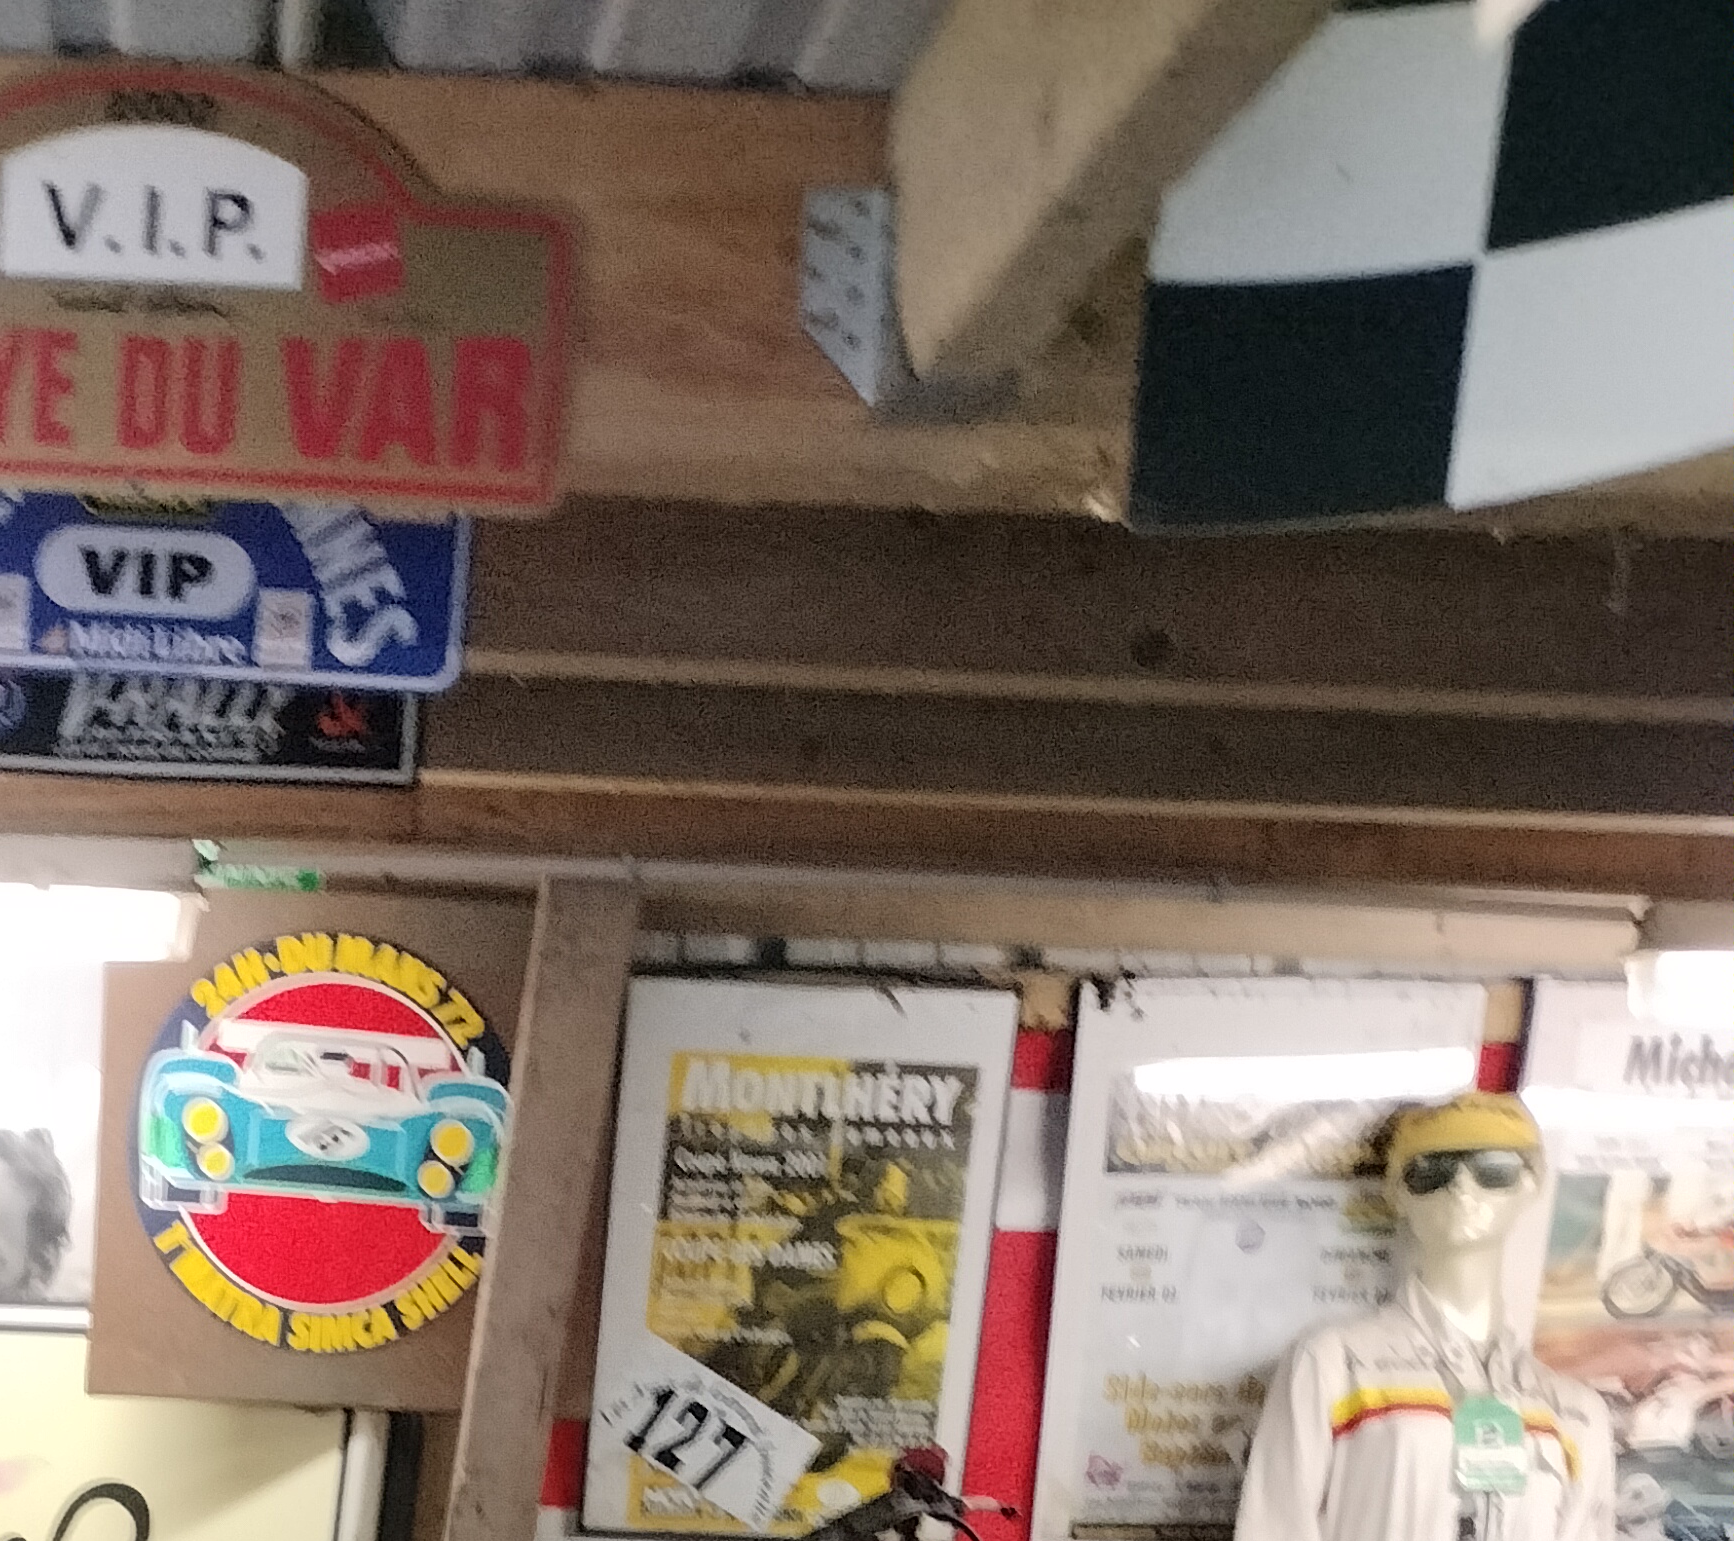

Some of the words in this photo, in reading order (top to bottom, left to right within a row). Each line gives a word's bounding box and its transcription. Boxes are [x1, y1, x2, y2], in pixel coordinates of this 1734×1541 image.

[117, 332, 240, 455] DU
[281, 337, 530, 470] VAR
[77, 544, 215, 601] VIP
[286, 1306, 399, 1354] SIMCA
[622, 1386, 747, 1490] 127
